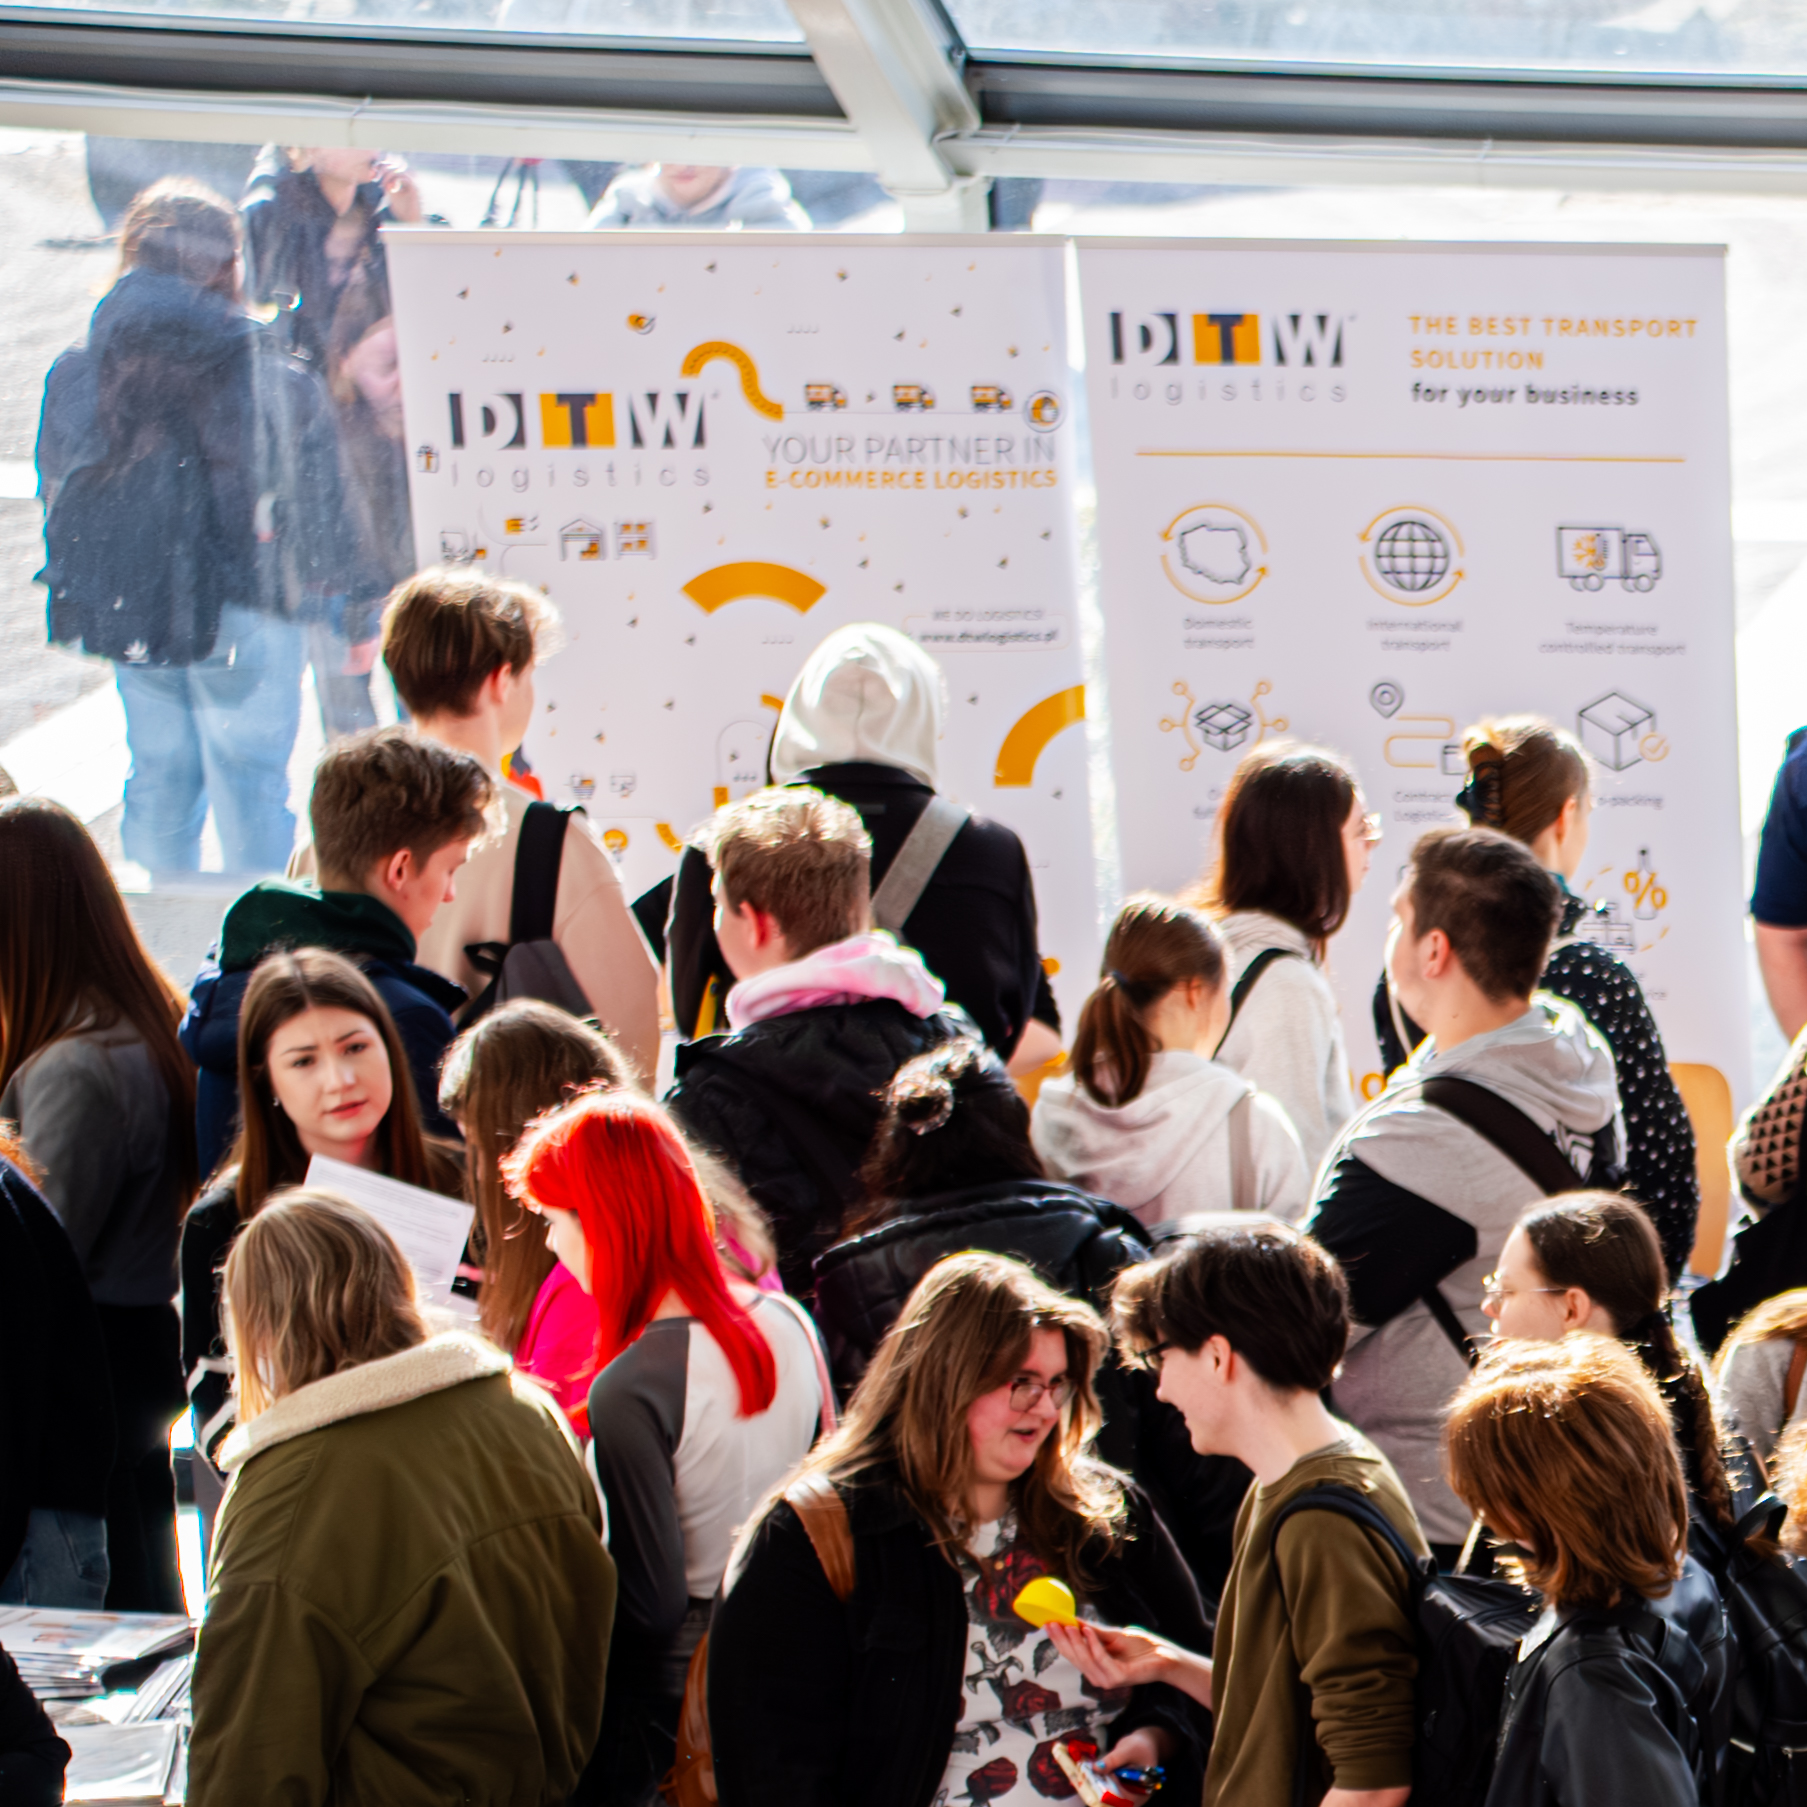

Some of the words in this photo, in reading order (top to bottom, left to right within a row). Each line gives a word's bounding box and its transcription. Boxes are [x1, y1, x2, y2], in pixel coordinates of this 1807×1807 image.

[1109, 312, 1345, 366] DTW
[1408, 315, 1457, 338] THE
[1468, 316, 1533, 338] BEST
[1541, 317, 1698, 340] TRANSPORT
[1408, 349, 1545, 371] SOLUTION
[1110, 375, 1347, 406] logistics
[1411, 381, 1449, 405] for
[1457, 387, 1516, 408] your
[1524, 383, 1639, 407] business
[447, 391, 708, 451] DTW
[763, 433, 860, 466] YOUR
[864, 435, 1018, 466] PARTNER
[1023, 435, 1056, 465] IN
[450, 461, 712, 495] logistics
[764, 468, 927, 491] E-COMMERCE
[933, 467, 1058, 490] LOGISTICS
[1365, 618, 1464, 634] International
[1564, 621, 1659, 638] Temperature
